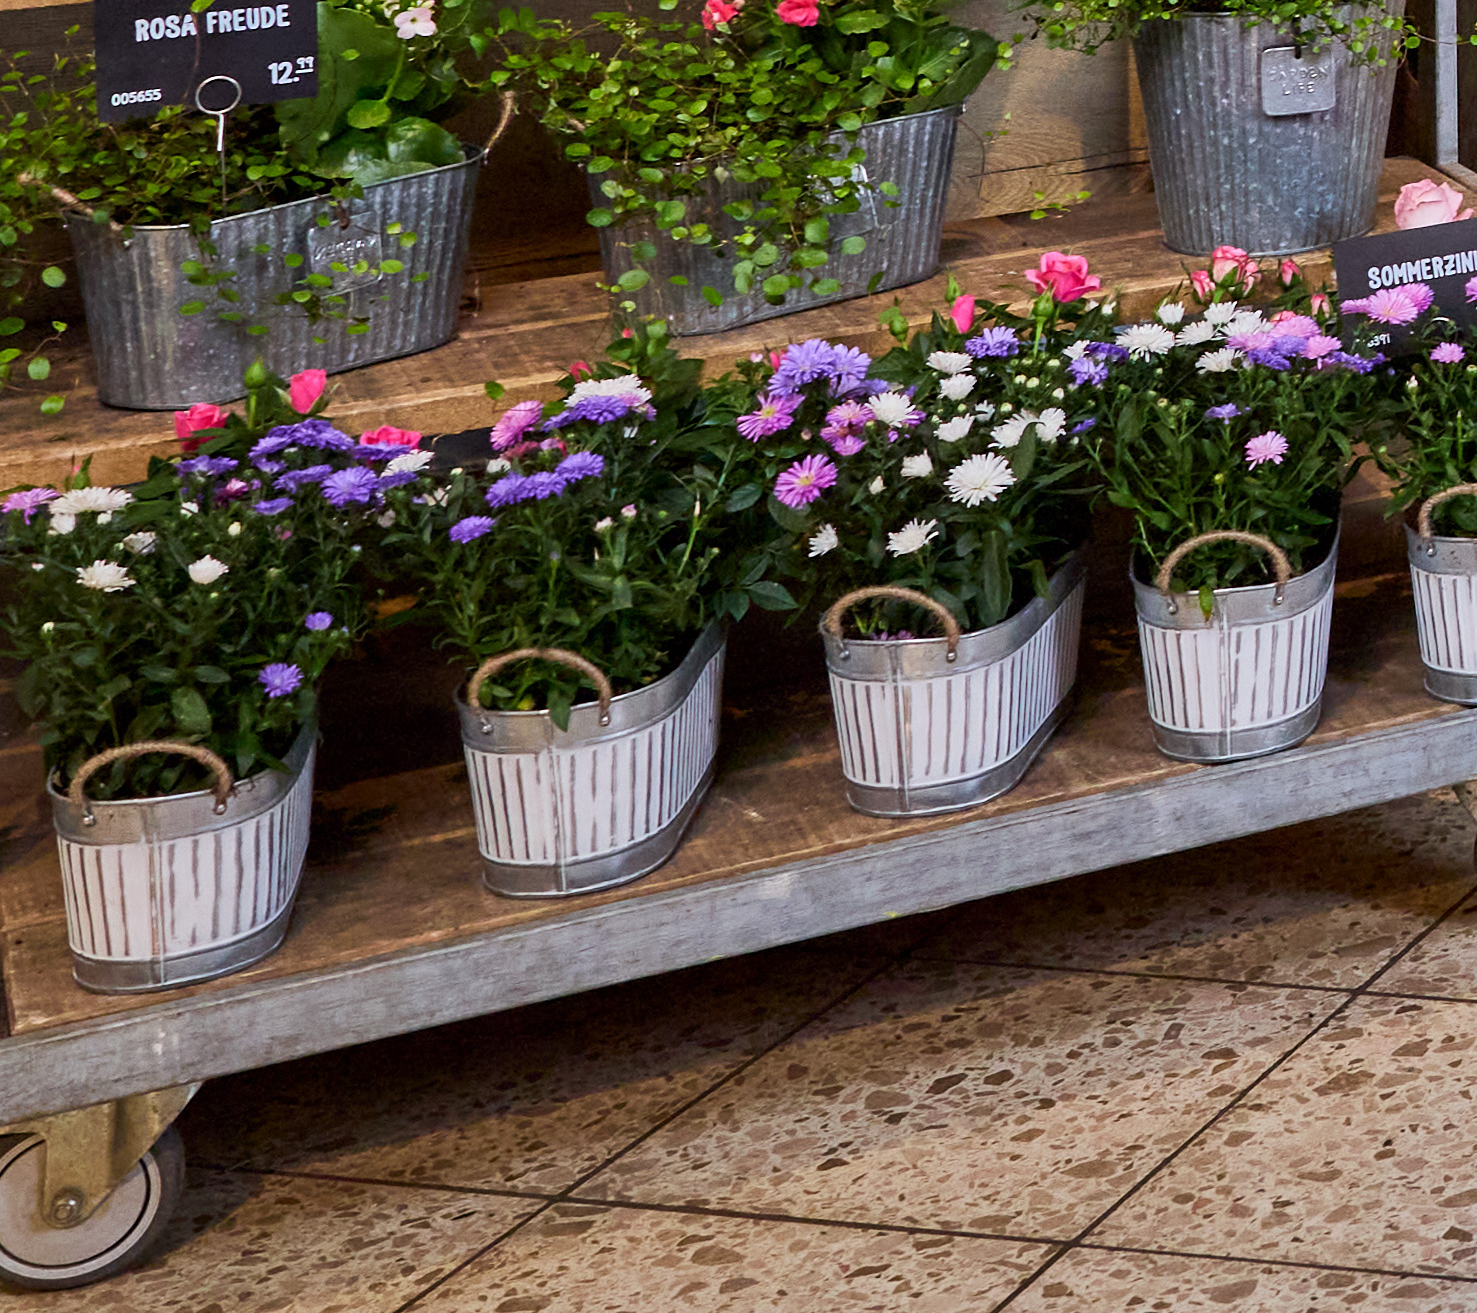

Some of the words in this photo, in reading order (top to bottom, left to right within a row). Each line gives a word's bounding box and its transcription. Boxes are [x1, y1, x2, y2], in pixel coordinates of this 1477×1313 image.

[135, 14, 197, 42] ROSA
[206, 4, 291, 34] FREUDE
[112, 89, 162, 107] 005655
